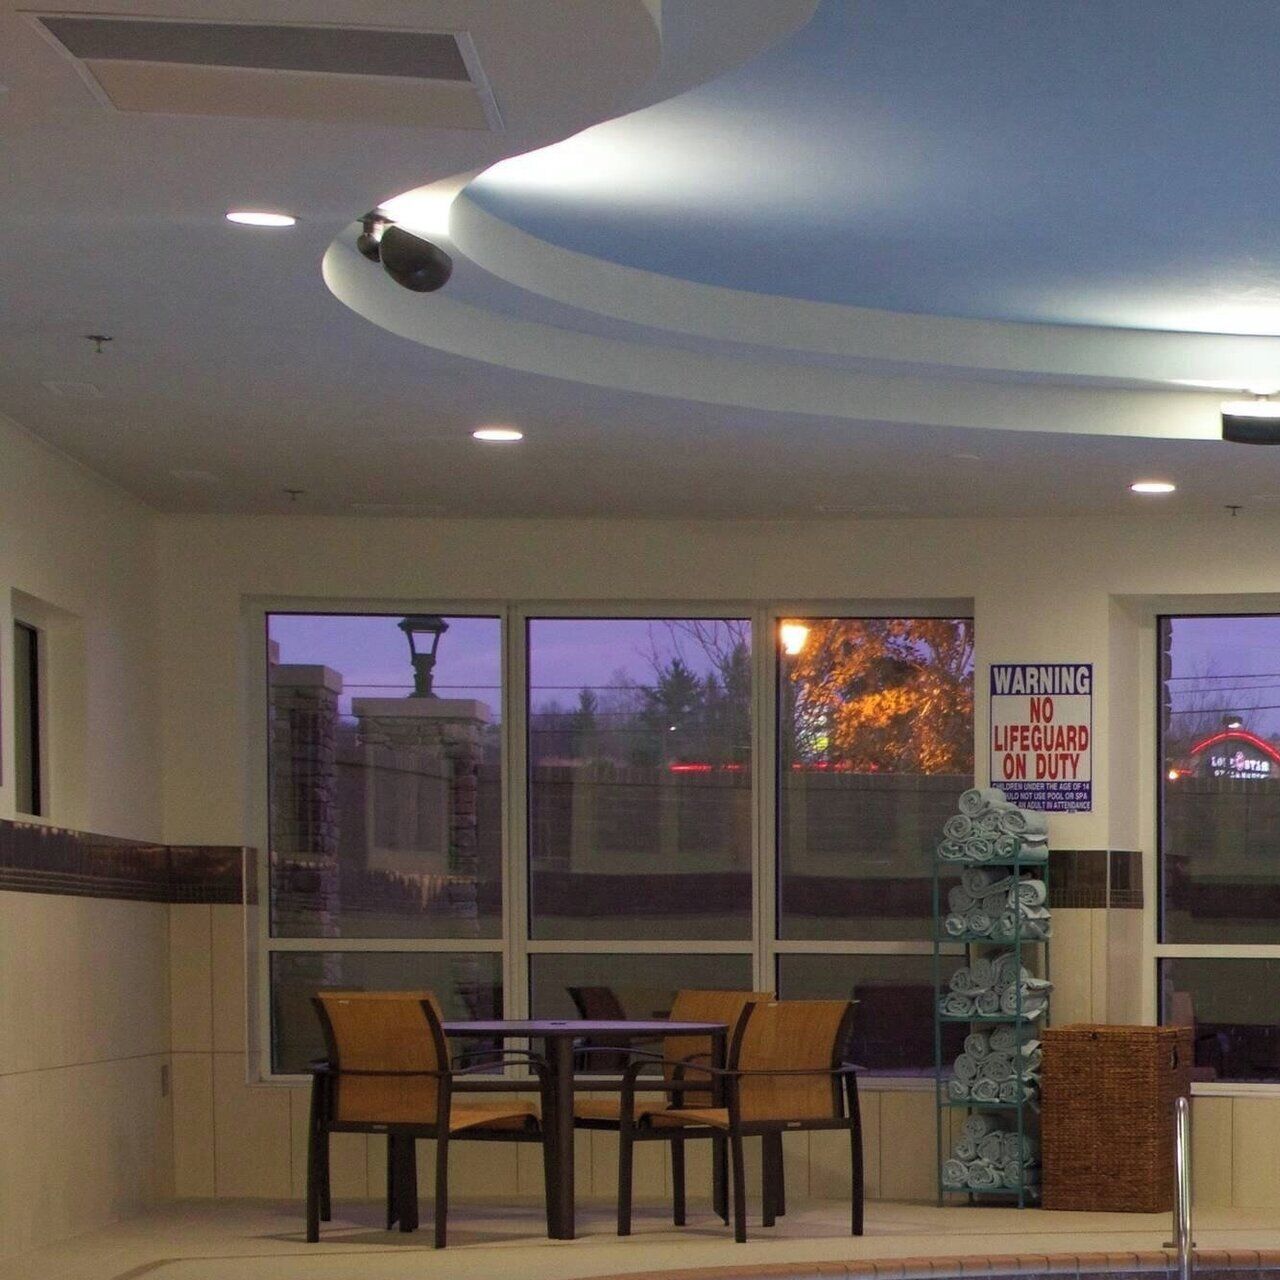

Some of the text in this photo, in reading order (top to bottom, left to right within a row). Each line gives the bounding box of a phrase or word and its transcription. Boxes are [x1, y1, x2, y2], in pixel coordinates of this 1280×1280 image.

[993, 666, 1090, 694] WARNING
[1029, 696, 1054, 723] NO
[993, 725, 1089, 751] LIFEGUARD
[1003, 753, 1080, 780] ON DUTY
[1020, 792, 1033, 800] NOT
[1034, 792, 1046, 800] USE
[1047, 792, 1064, 800] POOL
[1065, 792, 1074, 800] OR
[1075, 792, 1088, 800] SPA
[1024, 782, 1045, 791] UNDER
[1046, 782, 1058, 791] THE
[1059, 782, 1072, 791] AGE
[1073, 782, 1082, 791] OF
[1027, 801, 1046, 809] ADULT
[1046, 801, 1053, 809] IN
[1053, 801, 1091, 809] ATTENDANCE
